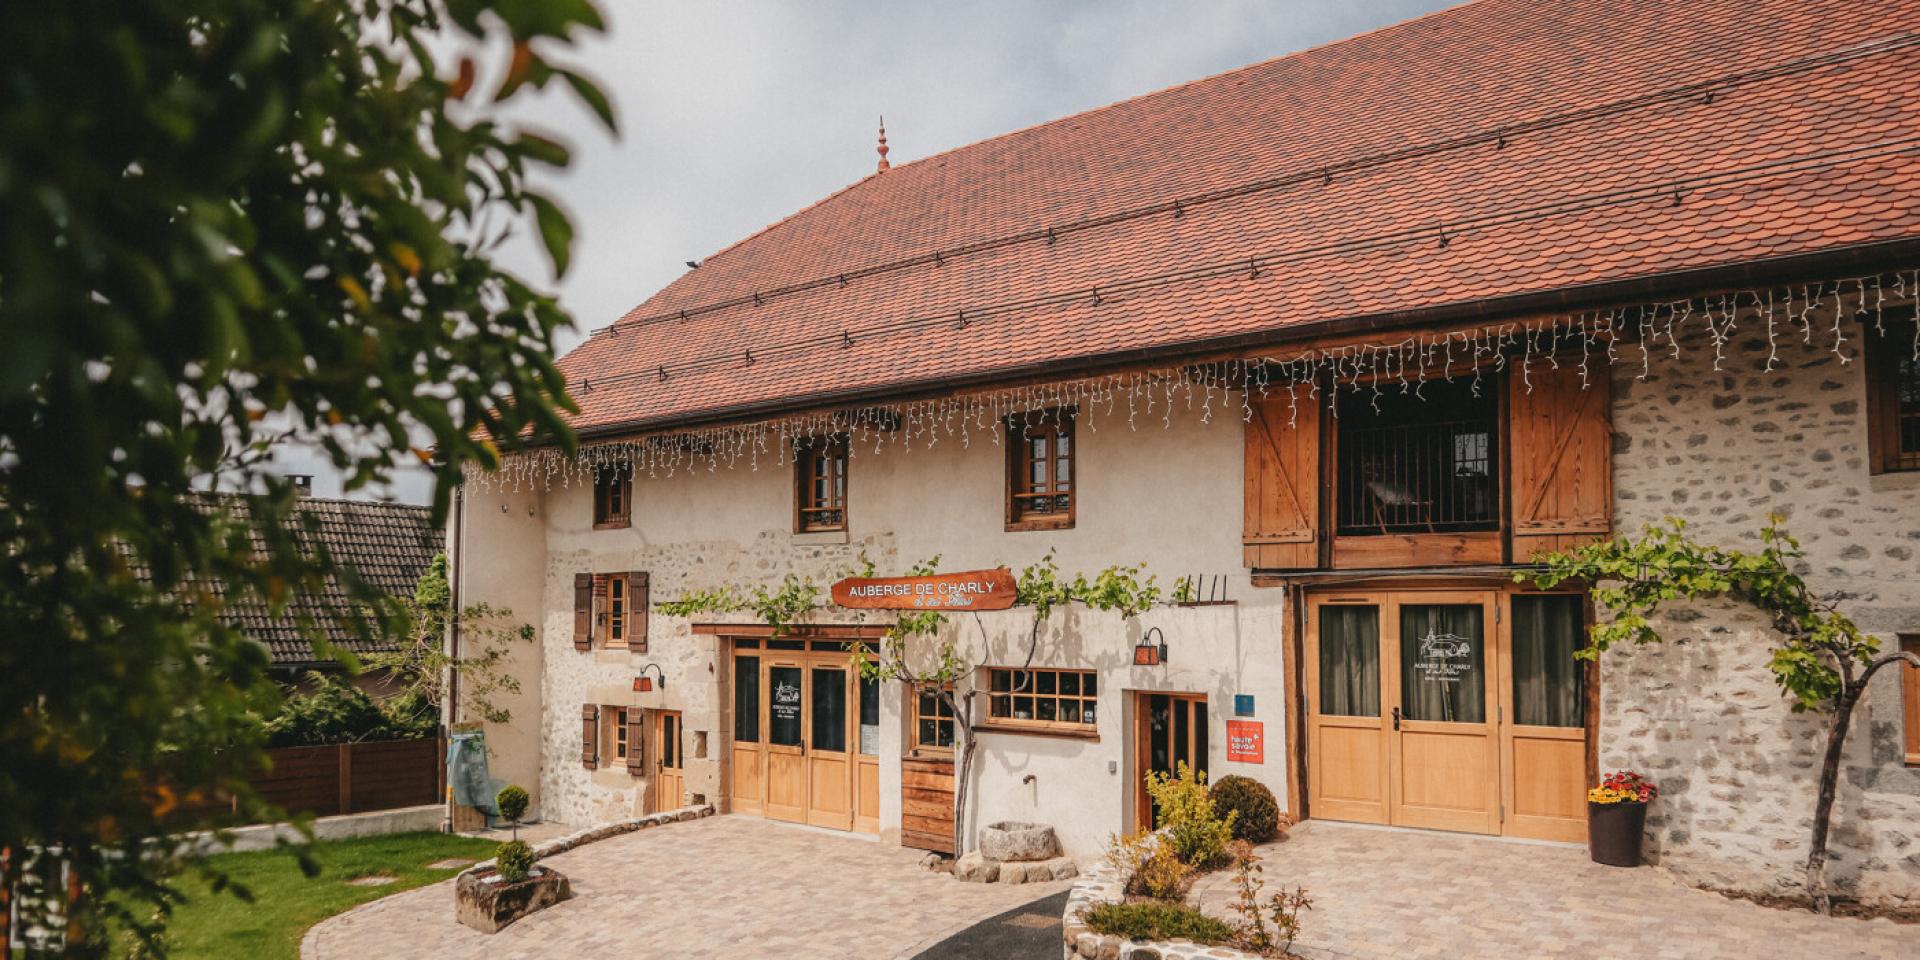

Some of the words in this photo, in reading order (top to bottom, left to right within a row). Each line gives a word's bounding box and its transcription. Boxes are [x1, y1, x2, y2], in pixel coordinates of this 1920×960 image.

[849, 584, 912, 597] AUBERGE
[915, 583, 934, 595] DE
[937, 581, 995, 595] CHARLY
